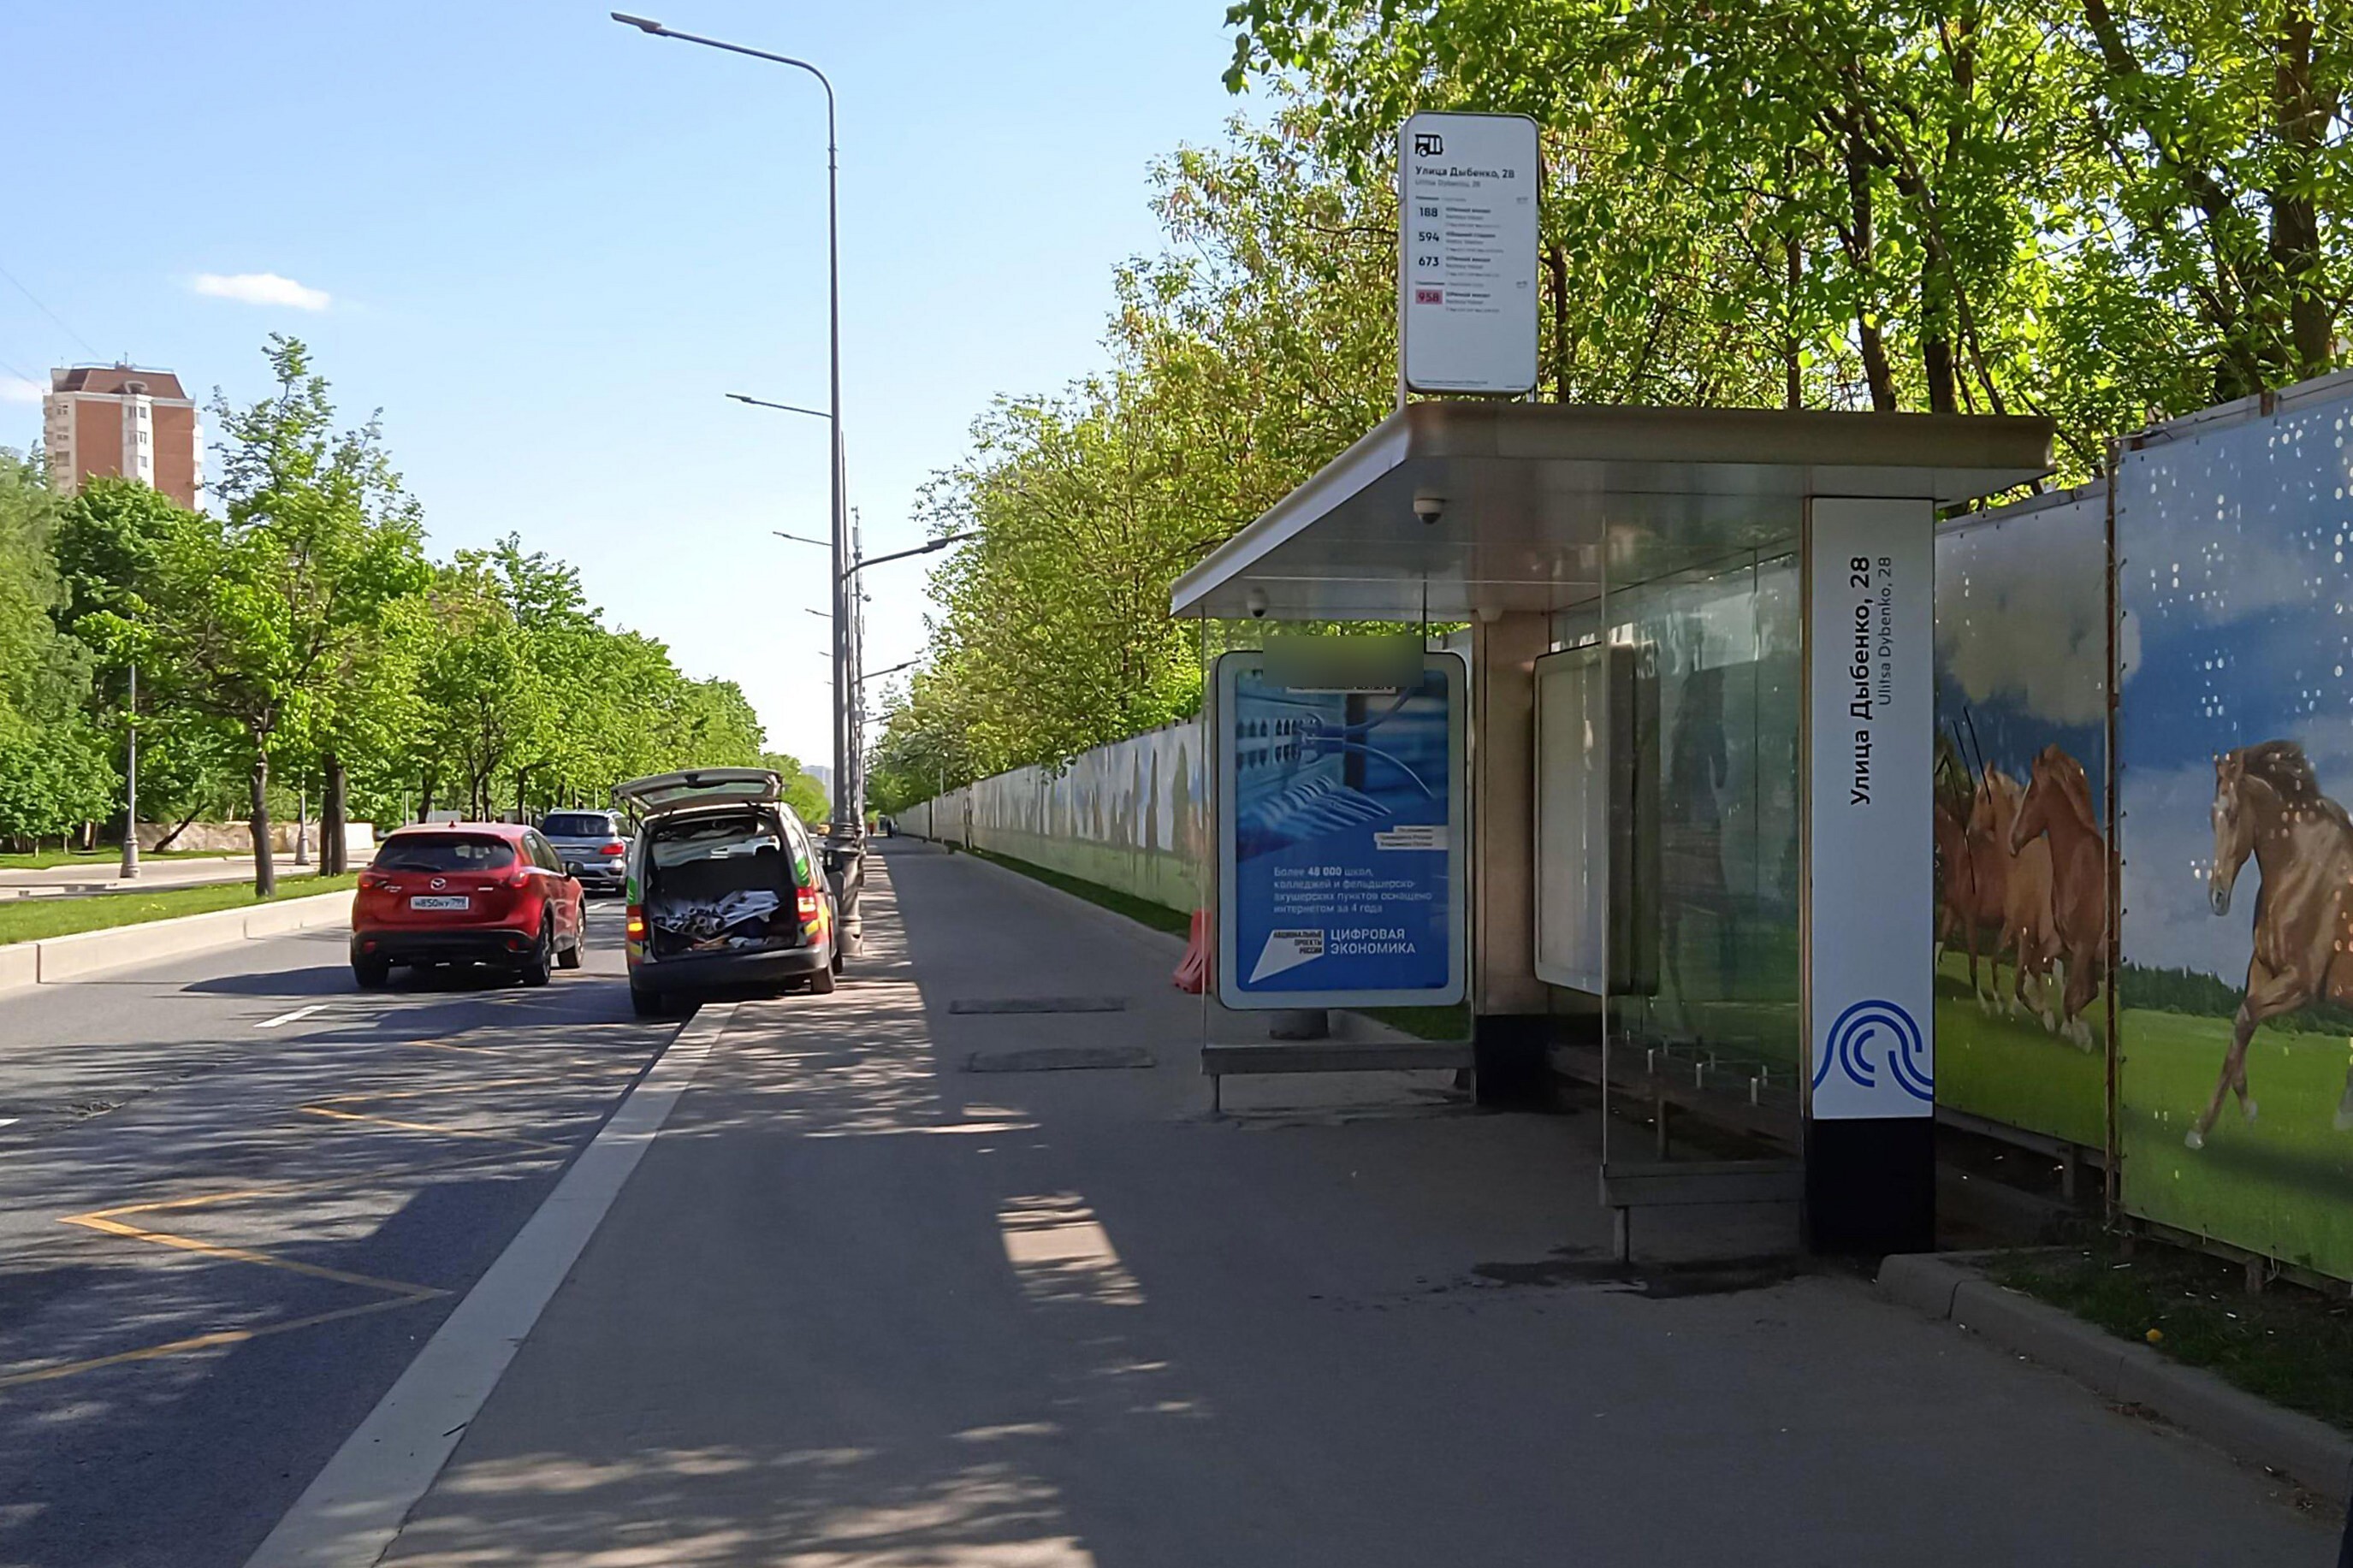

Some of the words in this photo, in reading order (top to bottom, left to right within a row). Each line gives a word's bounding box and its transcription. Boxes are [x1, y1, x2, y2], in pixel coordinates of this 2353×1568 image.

[1415, 166, 1448, 177] Улица
[1449, 168, 1500, 180] Дыбенко,
[1502, 169, 1515, 178] 28
[1420, 207, 1438, 217] 188
[1419, 232, 1440, 242] 594
[1419, 257, 1439, 267] 673
[1419, 293, 1439, 302] 958
[1850, 557, 1870, 589] 28
[1878, 557, 1891, 577] 28
[1878, 583, 1894, 657] Dybenko,
[1850, 598, 1873, 720] Дыбенко,
[1878, 662, 1891, 706] Ulitsa
[1850, 730, 1873, 805] Улица
[1323, 867, 1342, 876] 000
[1337, 892, 1378, 902] пунктов
[1351, 903, 1357, 913] 4
[1360, 904, 1383, 914] года
[1331, 929, 1405, 941] ЦИФРОВАЯ
[1331, 943, 1416, 955] ЭКОНОМИКА
